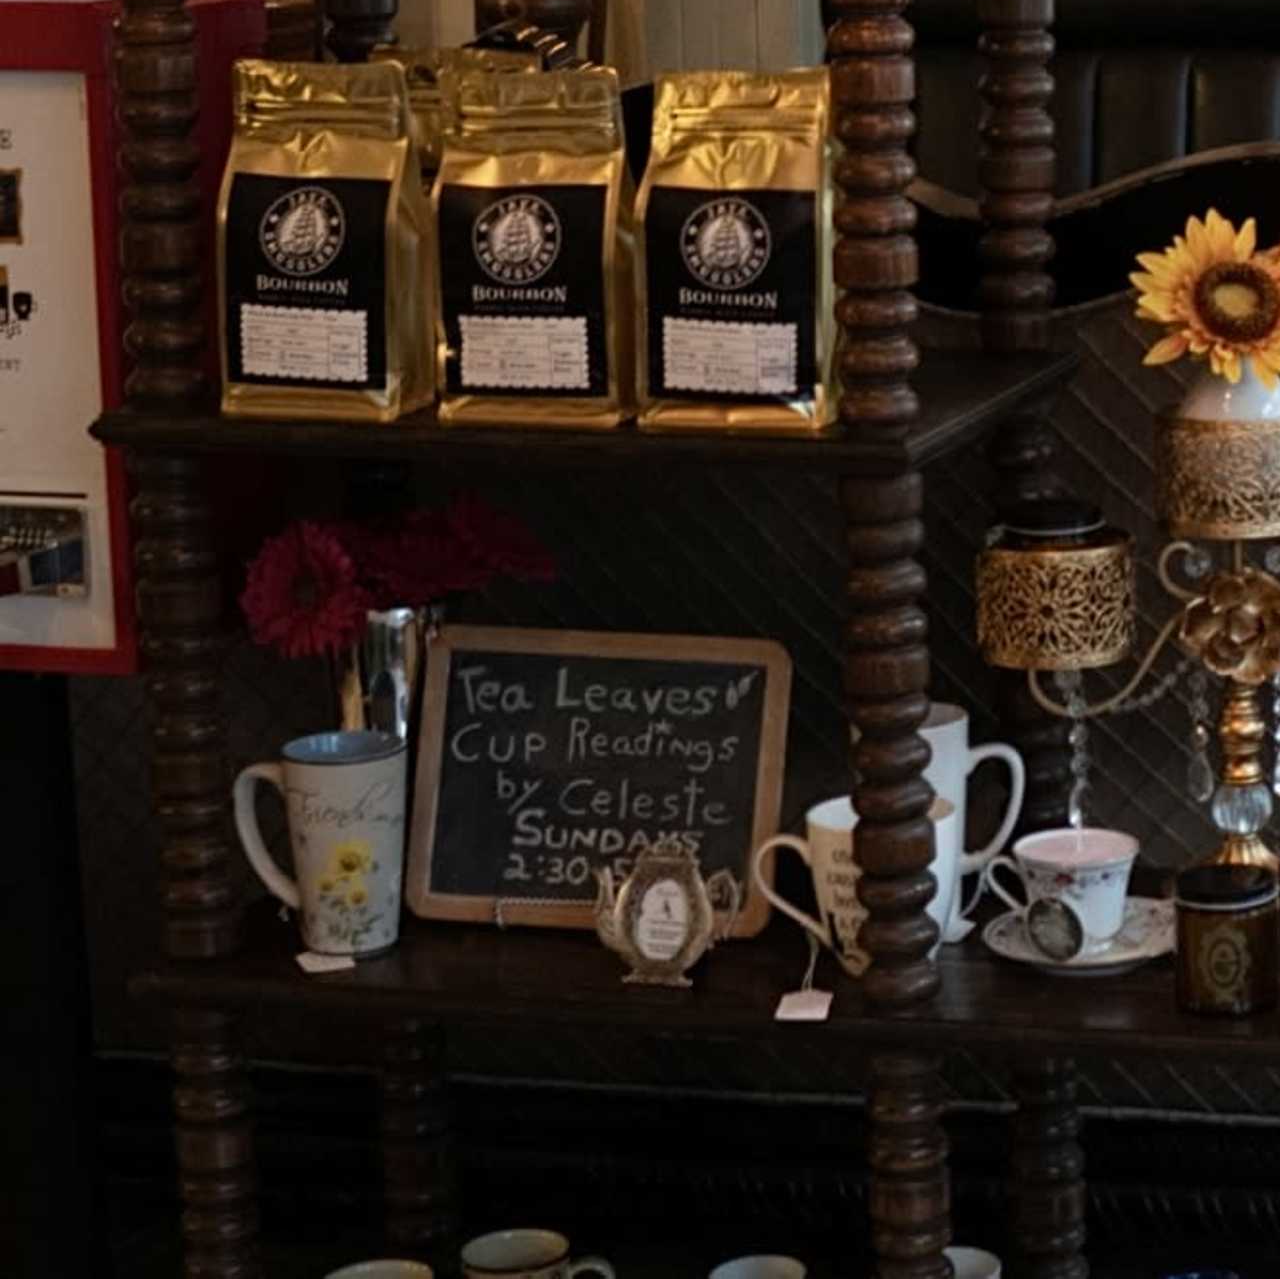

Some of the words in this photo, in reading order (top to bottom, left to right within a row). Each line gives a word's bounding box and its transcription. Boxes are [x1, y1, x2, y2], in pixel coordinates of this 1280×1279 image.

[256, 274, 350, 296] BOURBON
[471, 284, 568, 303] BOURBON
[678, 286, 779, 310] BOURBON
[458, 666, 533, 714] Tea
[556, 666, 719, 715] Leaves
[568, 717, 740, 773] Readings
[497, 772, 544, 815] by
[558, 777, 733, 827] Celeste
[502, 853, 590, 885] 2:30
